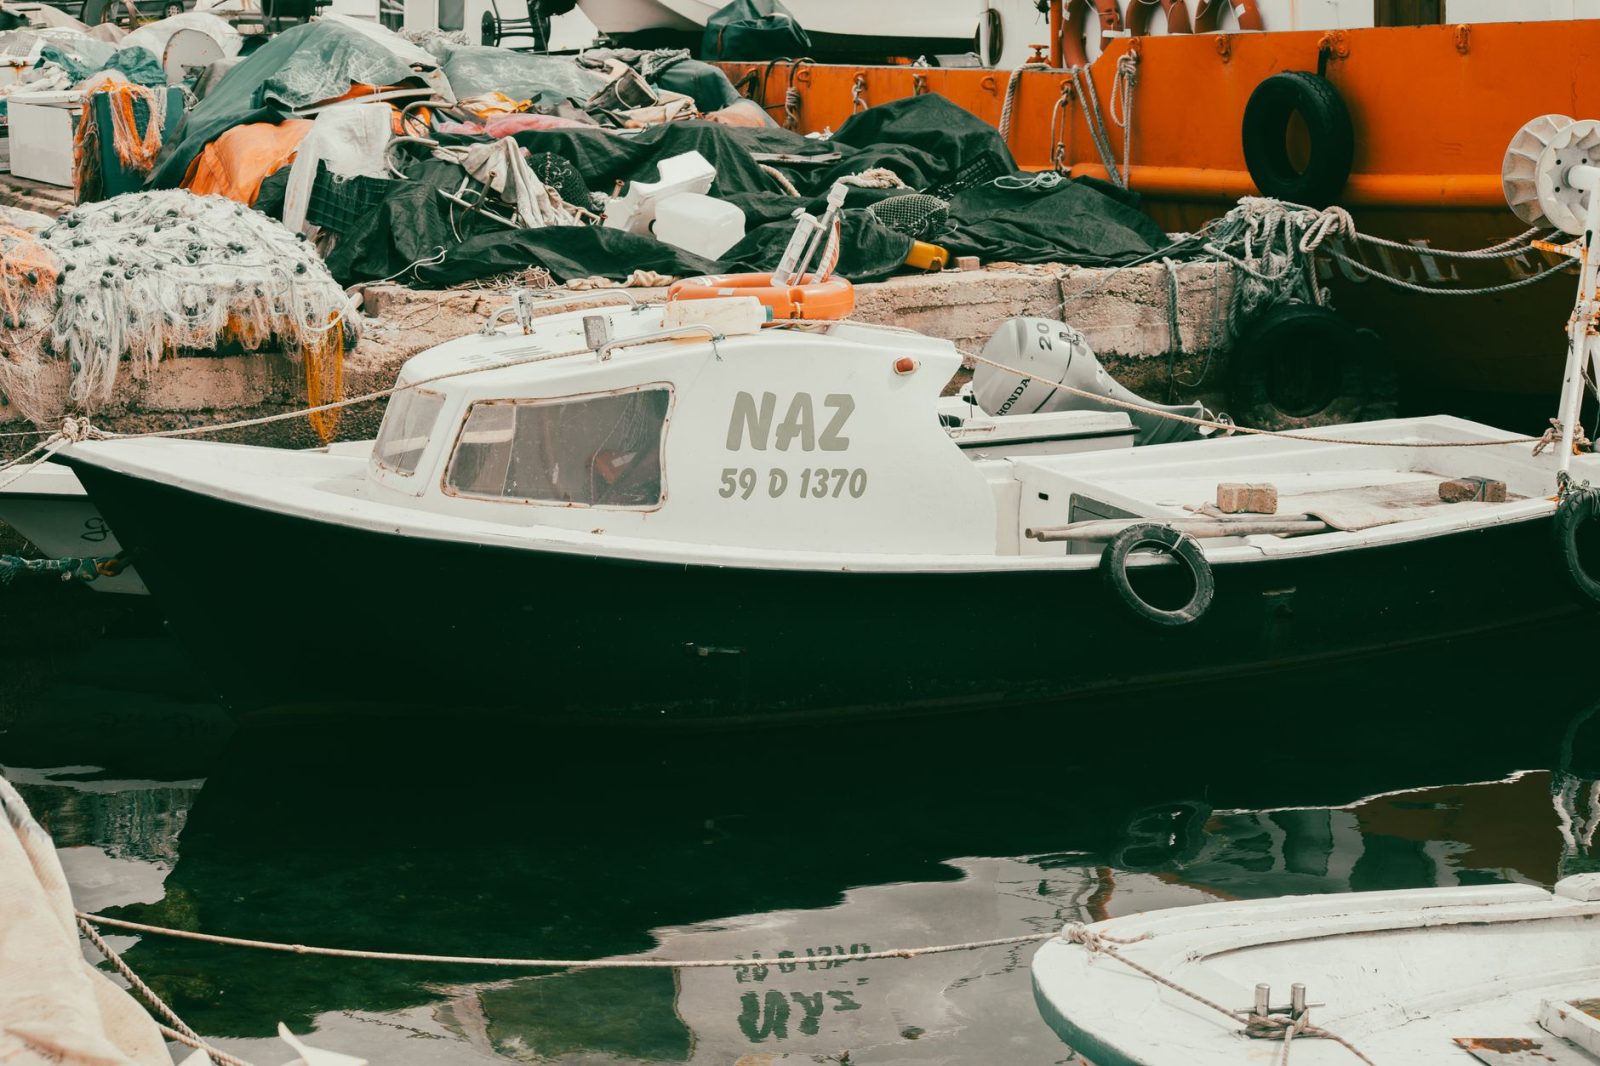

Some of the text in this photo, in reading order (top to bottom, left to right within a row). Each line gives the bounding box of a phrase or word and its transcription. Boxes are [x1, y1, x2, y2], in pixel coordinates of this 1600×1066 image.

[1036, 322, 1053, 351] 20
[996, 376, 1032, 416] HONDA
[725, 390, 856, 452] NAZ
[718, 467, 868, 500] 59 D 1370
